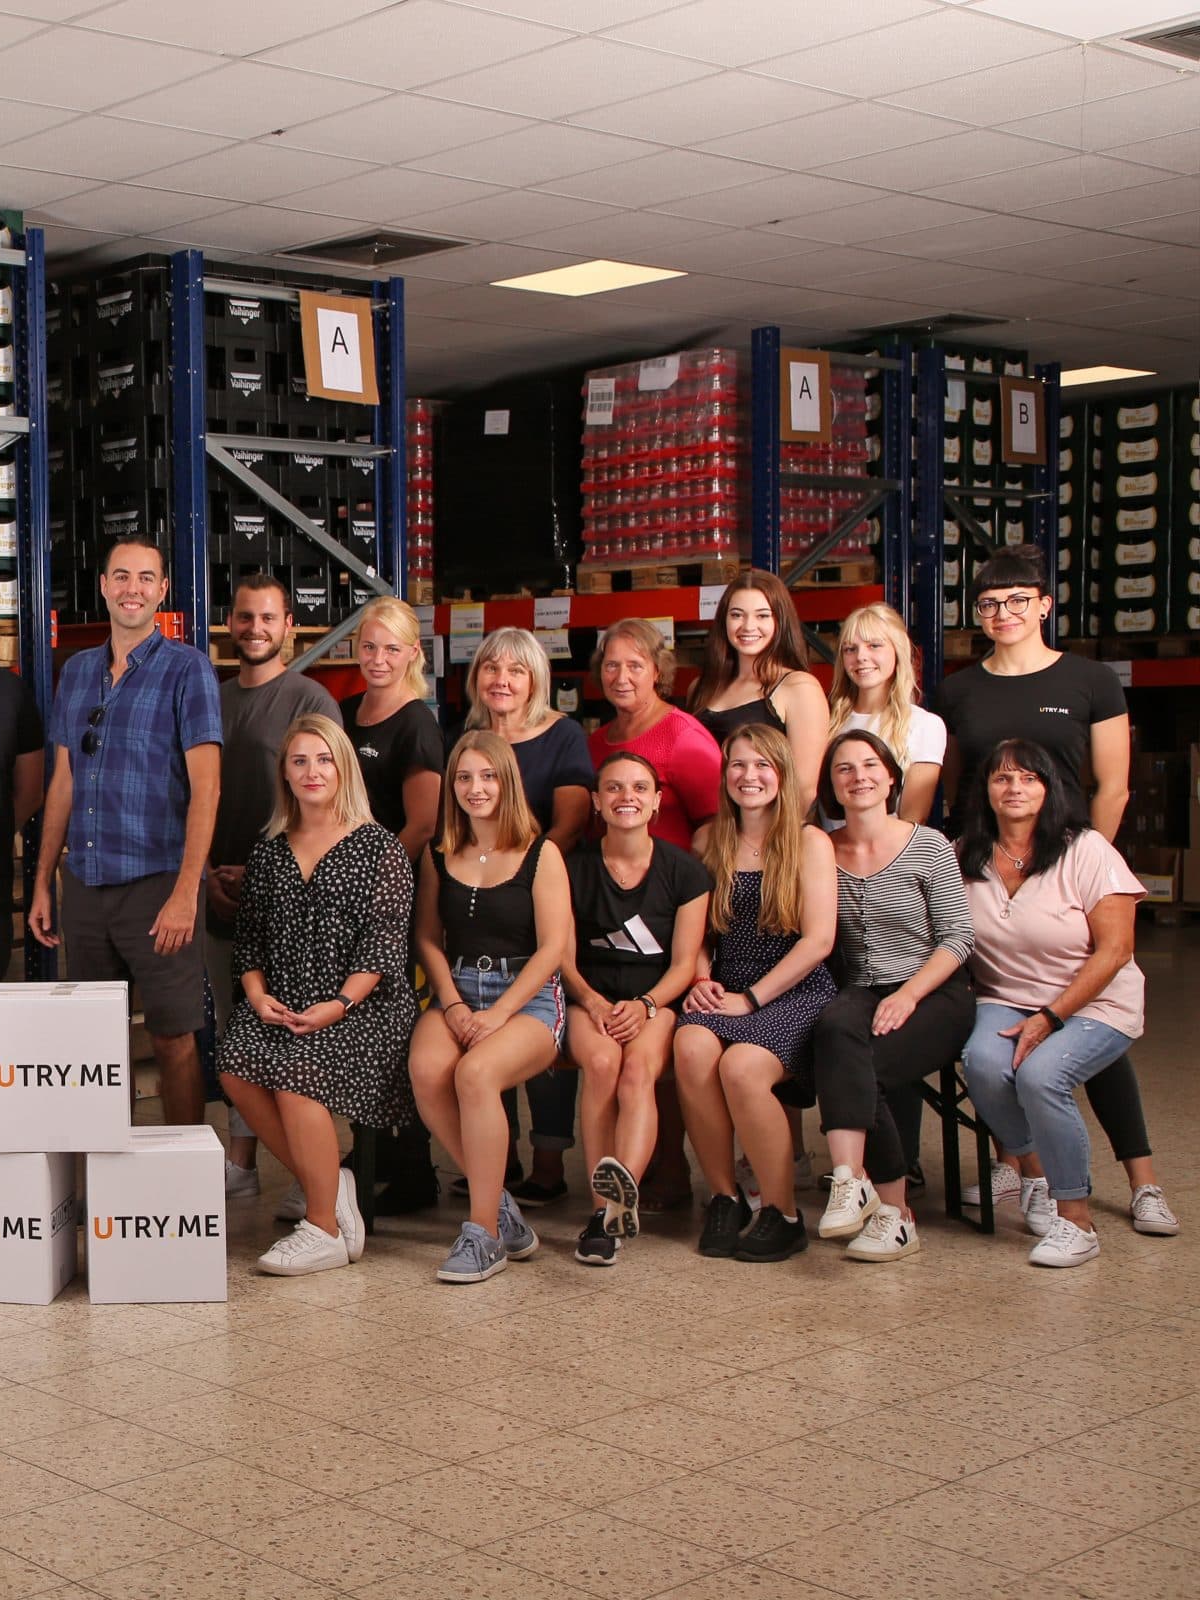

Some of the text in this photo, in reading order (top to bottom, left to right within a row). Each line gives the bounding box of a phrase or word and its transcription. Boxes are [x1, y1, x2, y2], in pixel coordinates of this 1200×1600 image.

[229, 306, 261, 320] Vaihinger
[331, 326, 349, 355] A
[230, 378, 262, 392] Vaihinger
[798, 375, 812, 400] A
[1019, 403, 1029, 425] B
[294, 455, 325, 467] Vaihinger
[351, 458, 374, 470] Vaihing
[233, 522, 265, 535] Vaihinger
[352, 528, 375, 539] Vaihing
[94, 1214, 220, 1240] UTRY.ME
